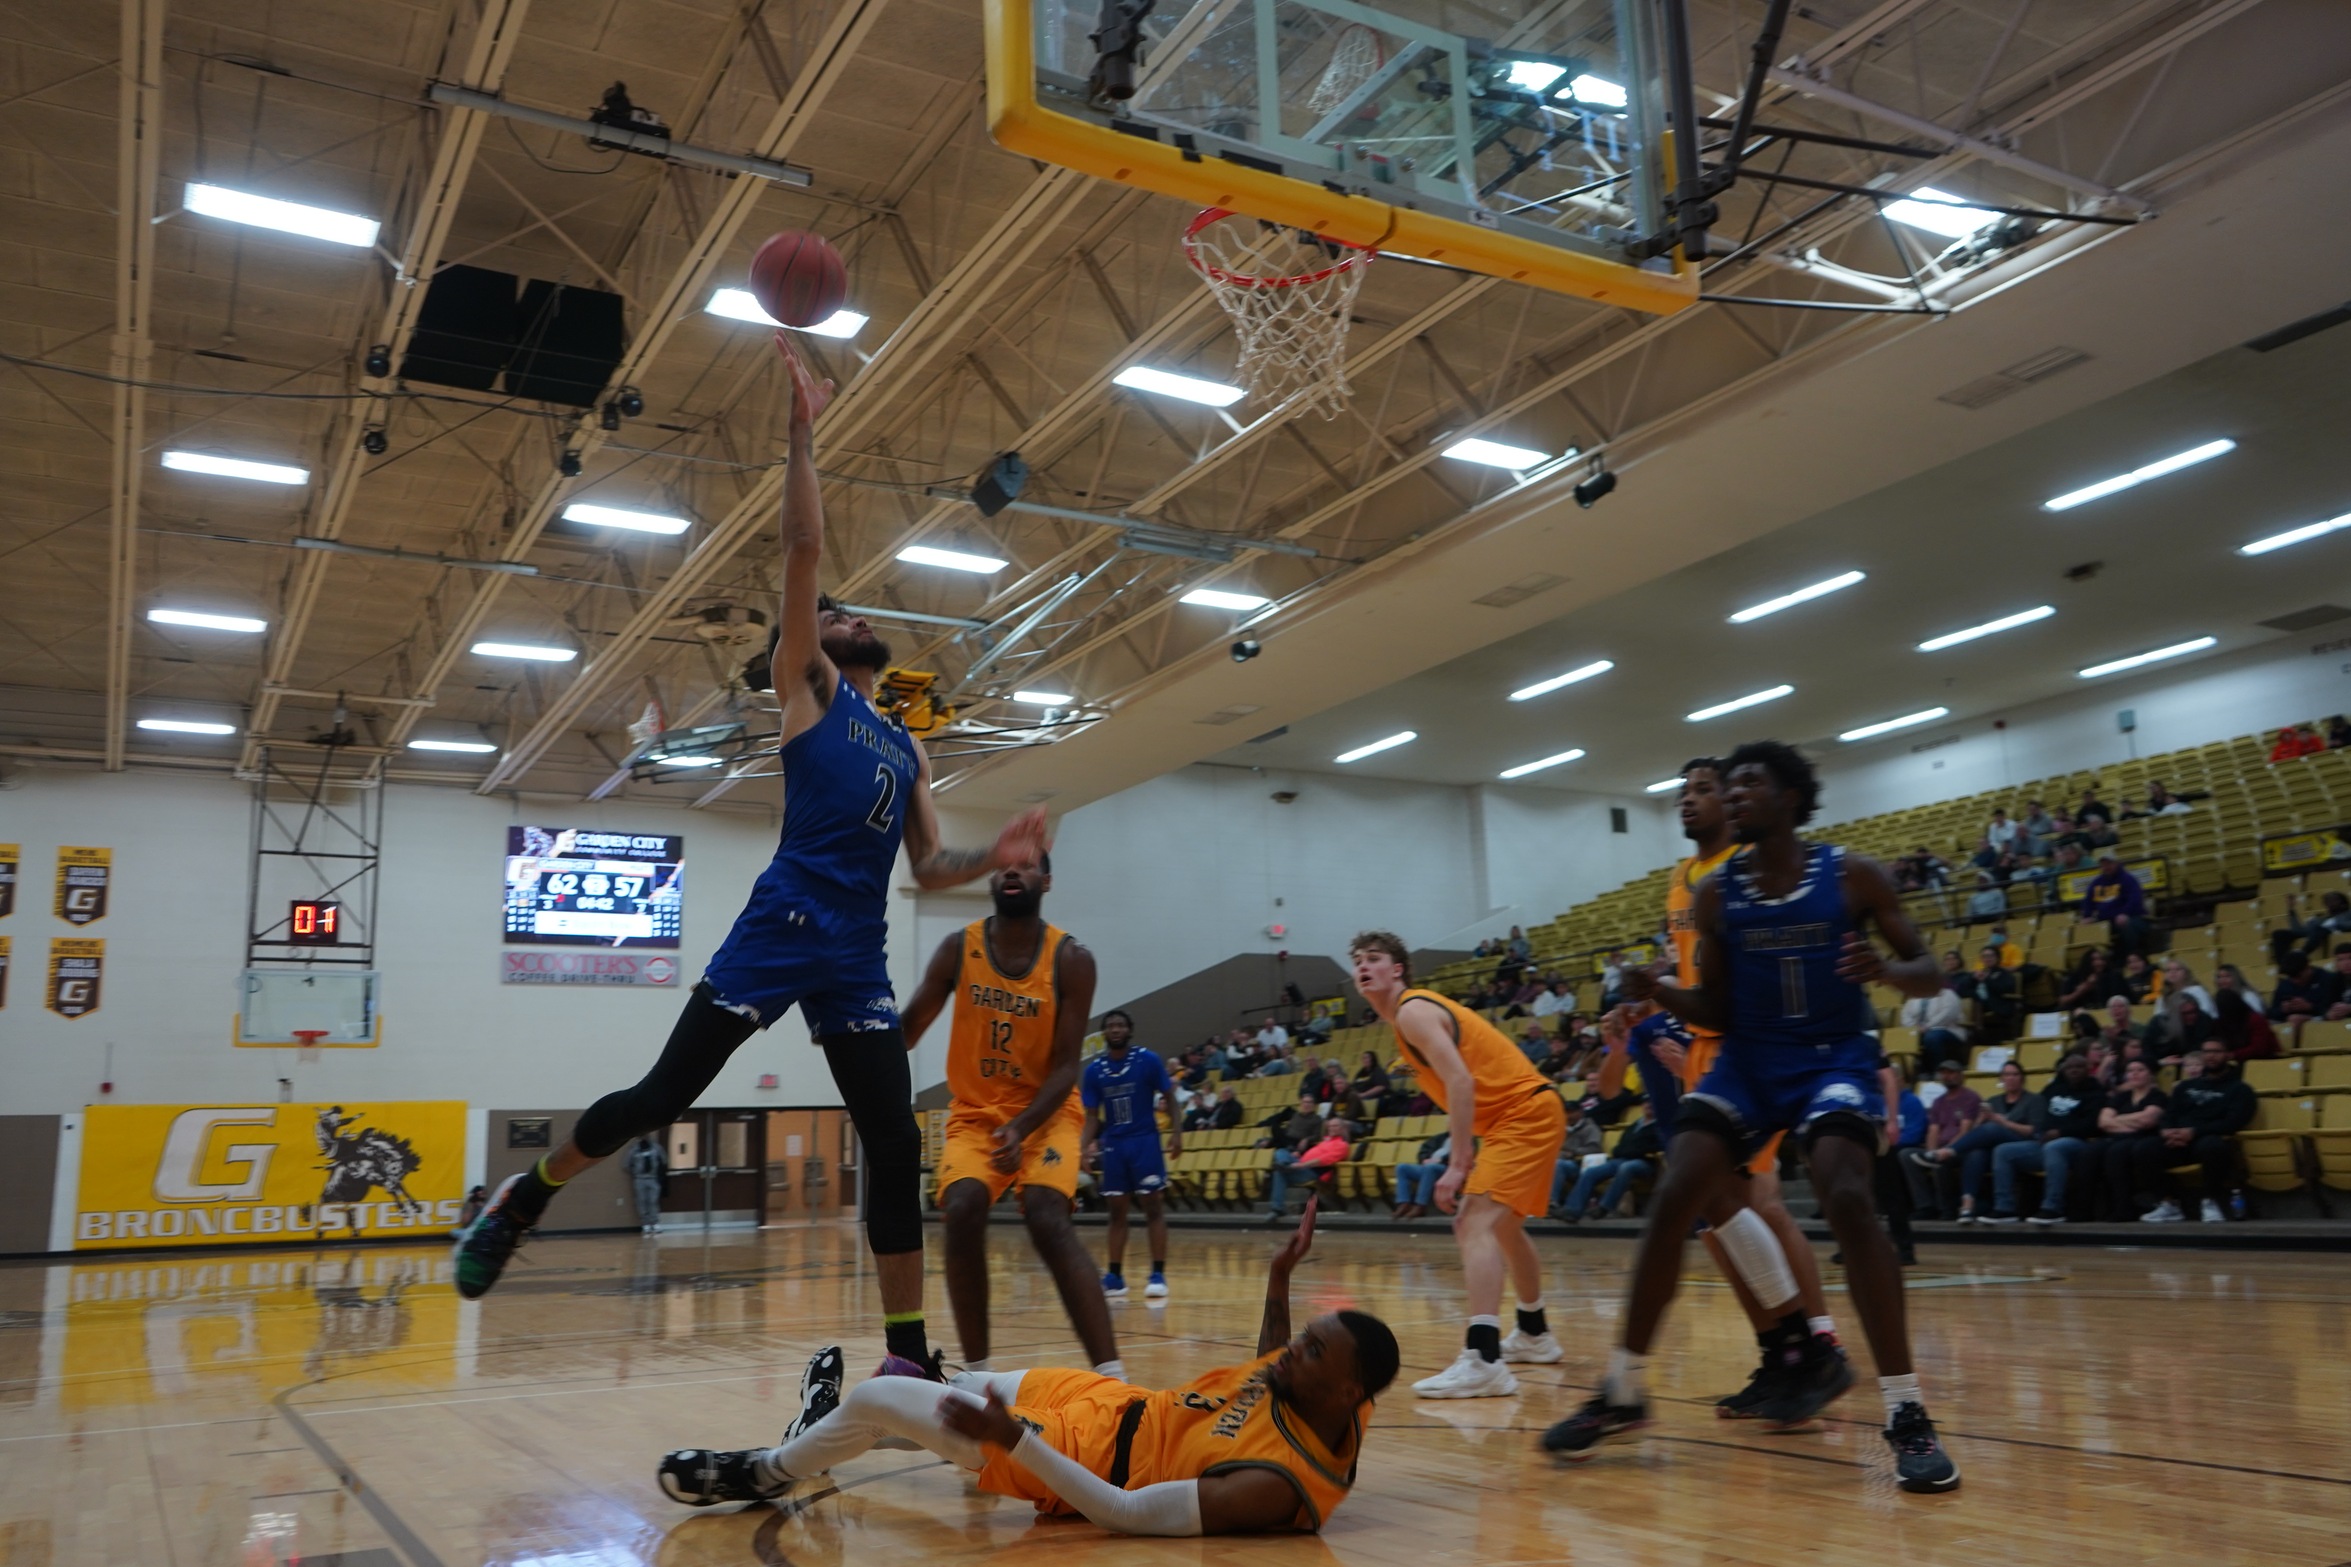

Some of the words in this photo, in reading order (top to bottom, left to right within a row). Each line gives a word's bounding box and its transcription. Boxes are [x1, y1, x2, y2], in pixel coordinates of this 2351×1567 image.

[865, 762, 897, 834] 2
[575, 833, 632, 849] GARDEN
[632, 837, 667, 850] CITY
[547, 873, 578, 895] 62
[614, 876, 644, 898] 57
[970, 984, 1041, 1018] GARDEN
[1778, 957, 1809, 1018] 1
[991, 1019, 1012, 1055] 12
[152, 1107, 281, 1204] G
[77, 1200, 463, 1241] BRONCBUSTERS
